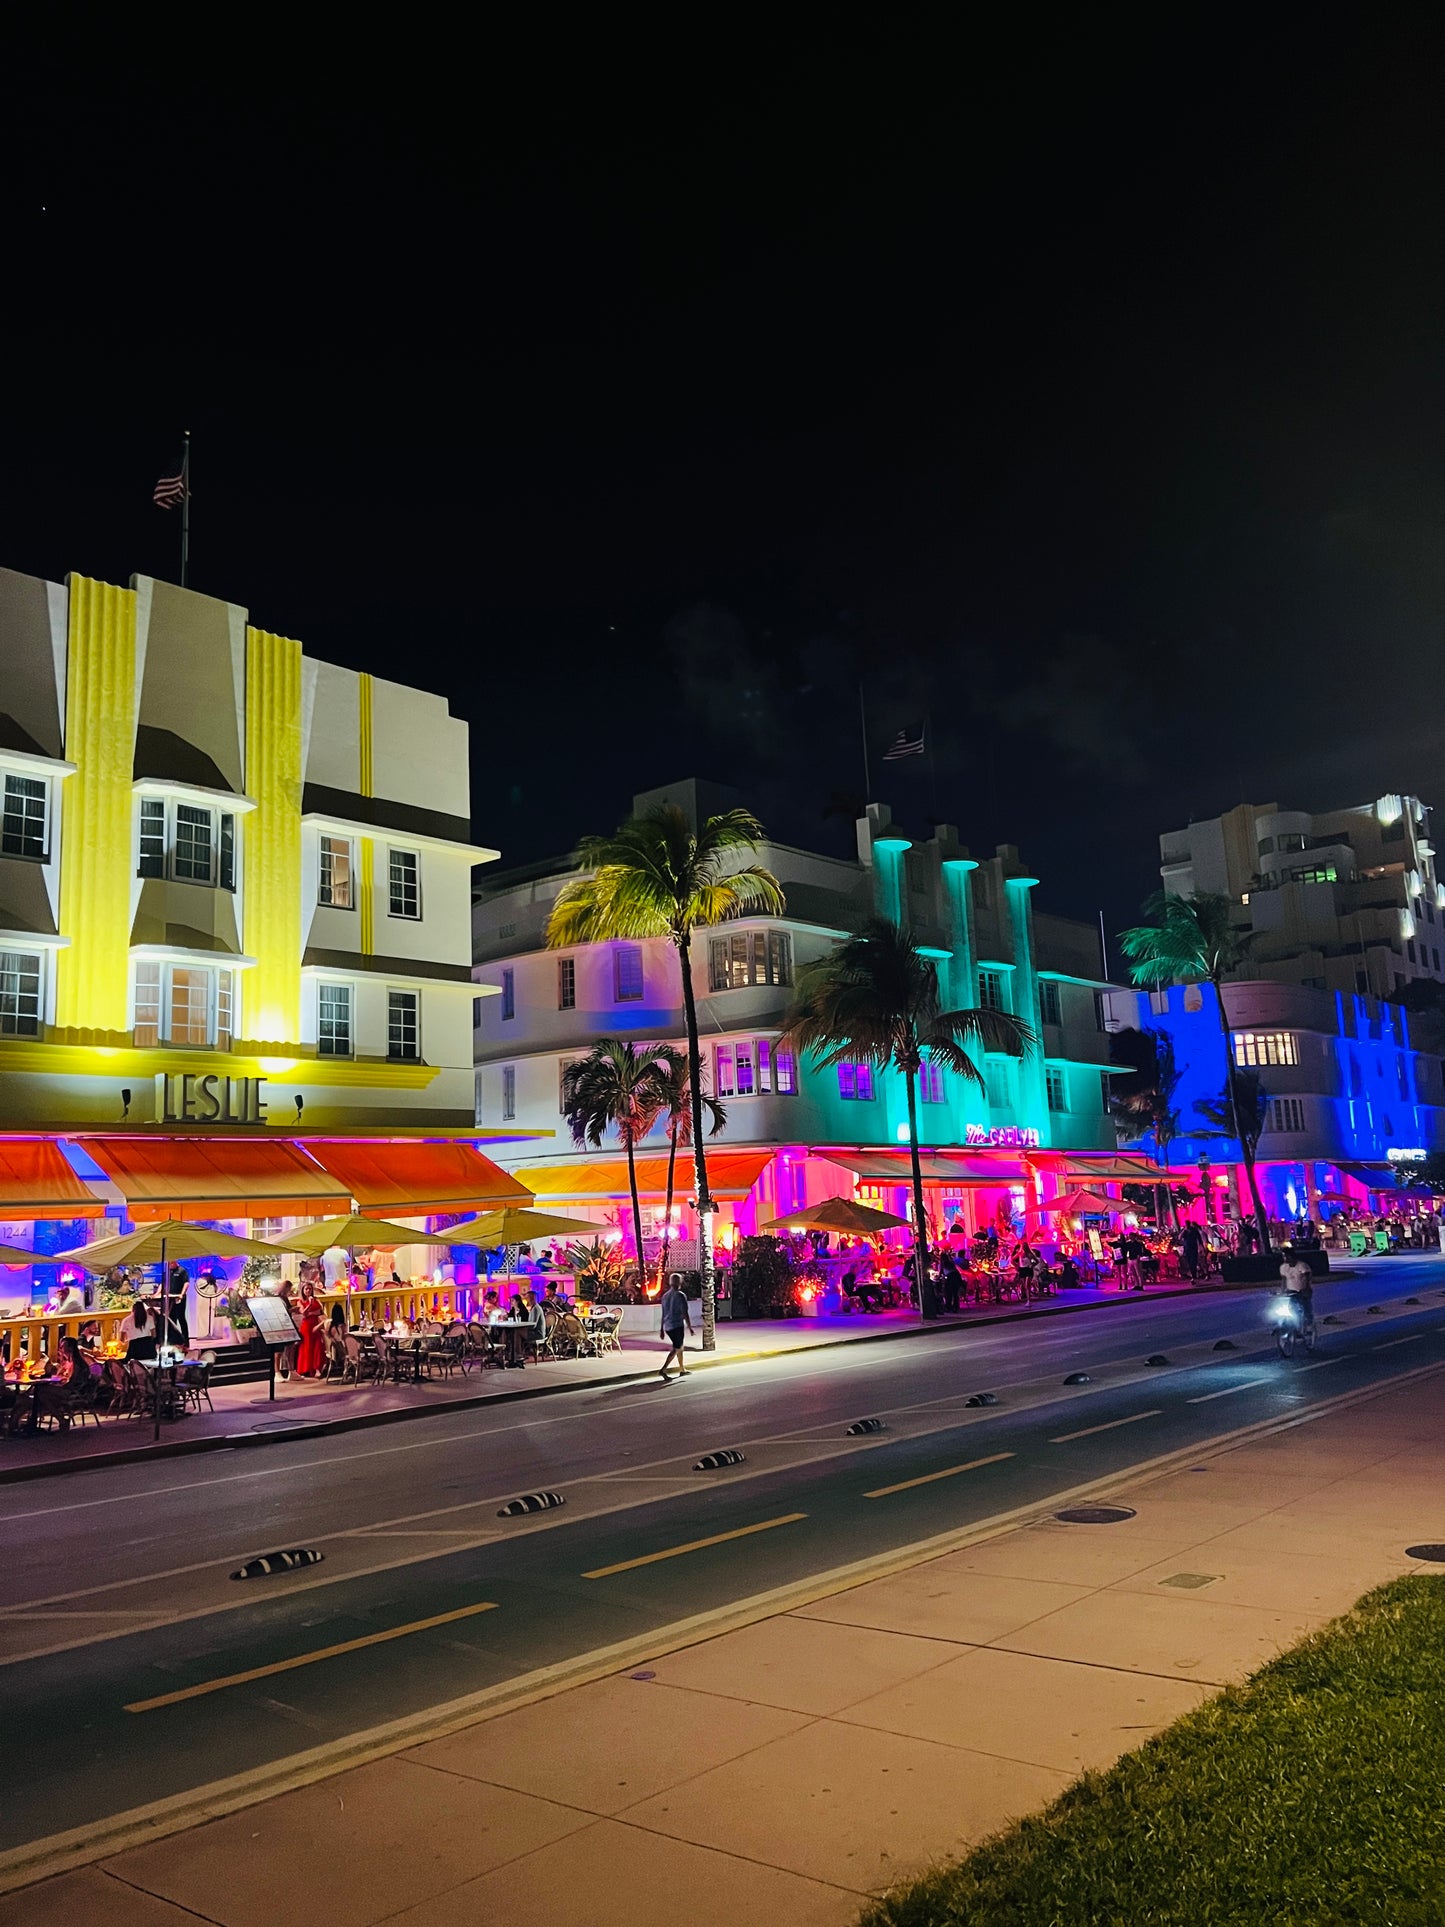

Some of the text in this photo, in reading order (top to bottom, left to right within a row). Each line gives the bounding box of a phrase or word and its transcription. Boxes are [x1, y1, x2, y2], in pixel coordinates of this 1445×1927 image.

[156, 1073, 268, 1121] LESLIE
[966, 1123, 987, 1145] The
[3, 1226, 27, 1239] 1244
